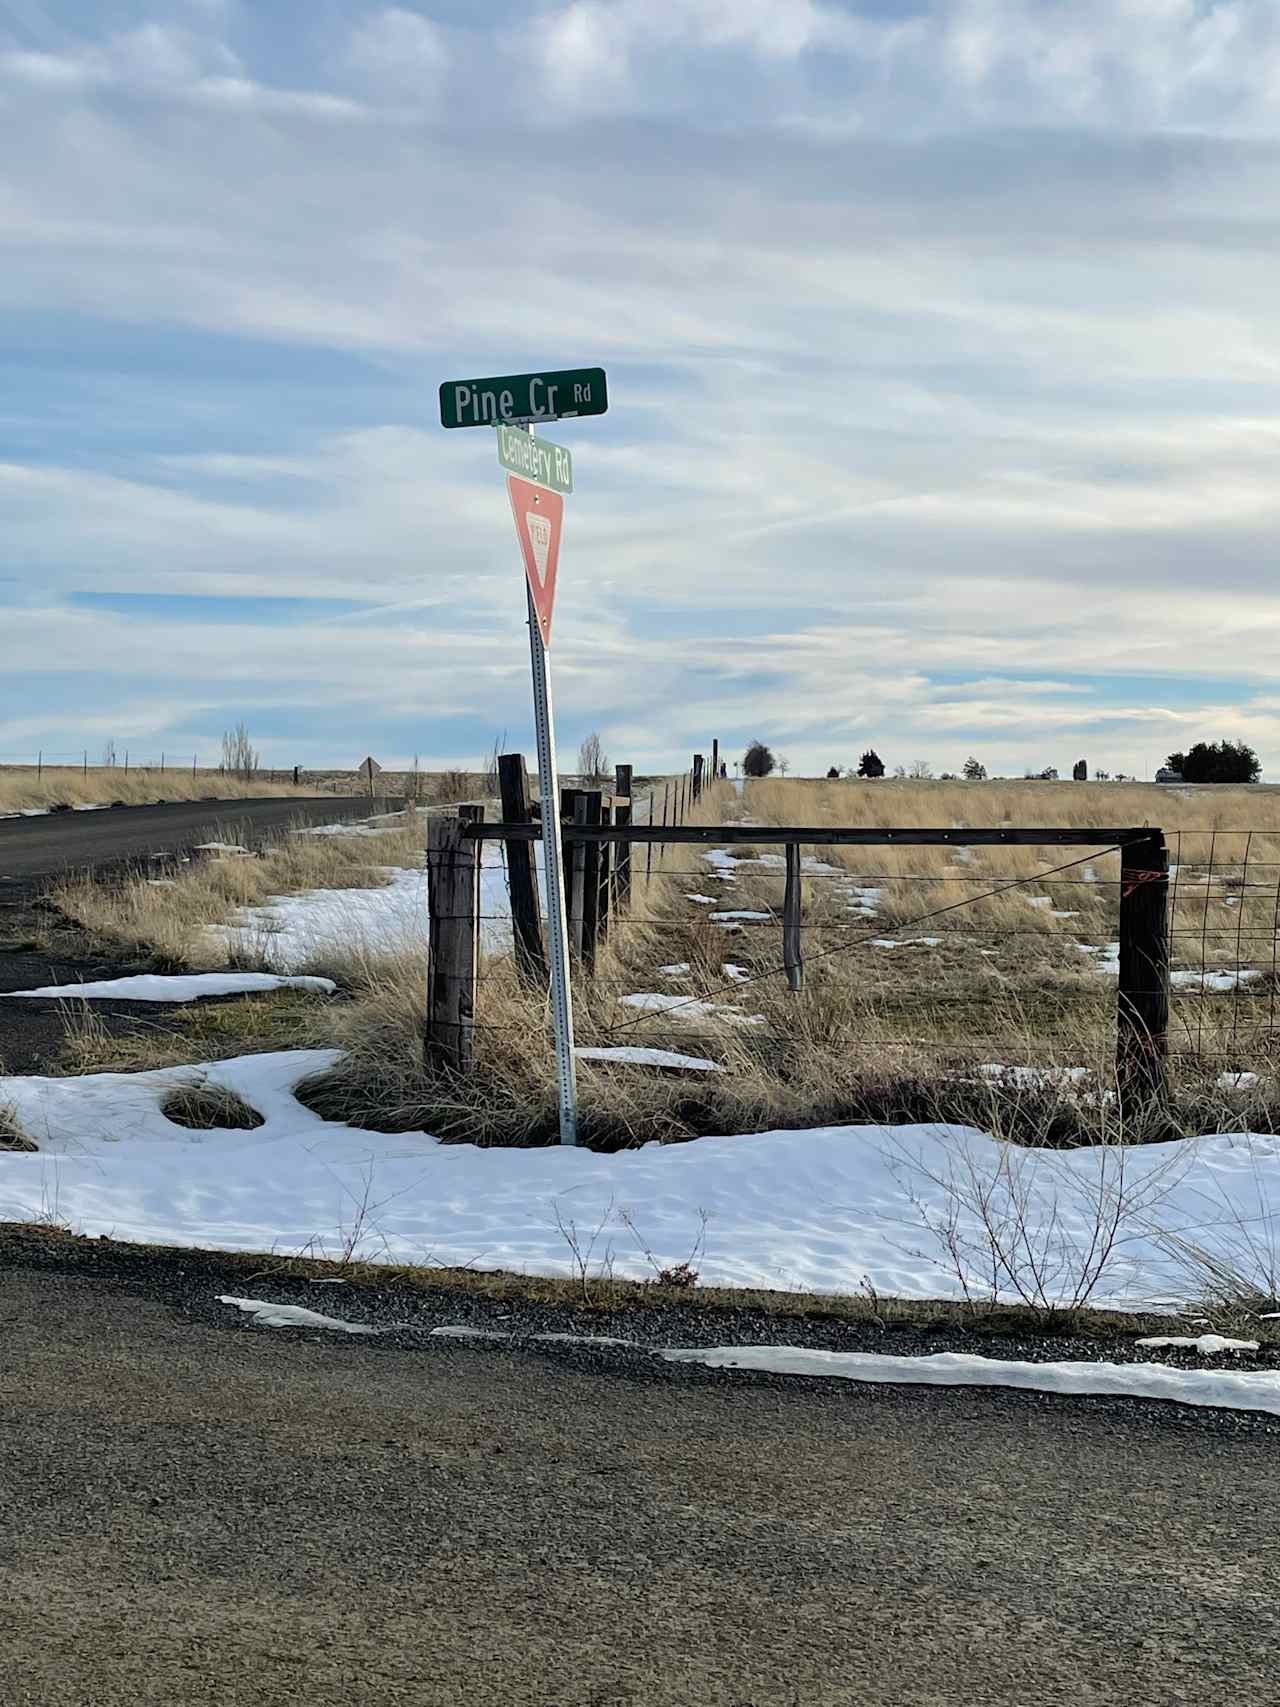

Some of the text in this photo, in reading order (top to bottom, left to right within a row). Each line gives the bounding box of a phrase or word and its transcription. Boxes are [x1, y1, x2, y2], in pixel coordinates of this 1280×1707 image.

[455, 378, 592, 423] Pine Cr Rd
[501, 426, 570, 485] Cemetery Rd
